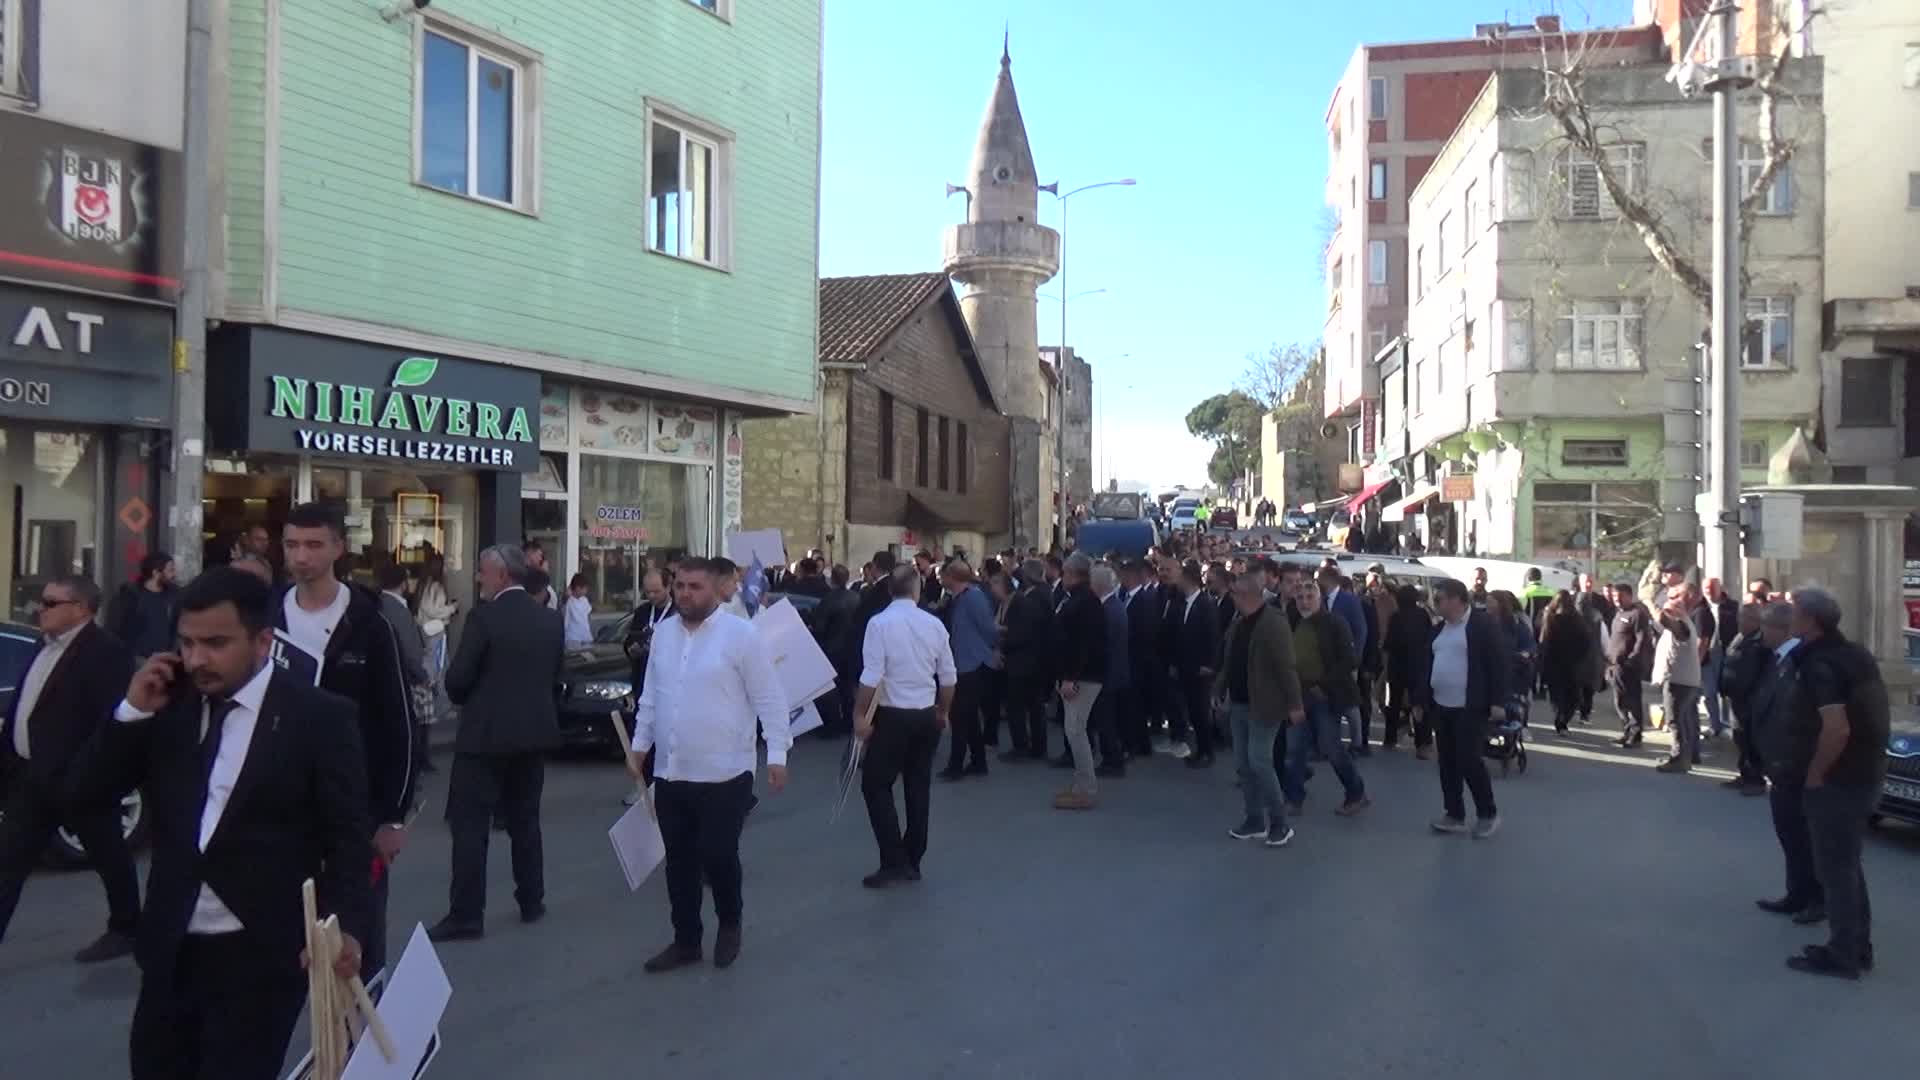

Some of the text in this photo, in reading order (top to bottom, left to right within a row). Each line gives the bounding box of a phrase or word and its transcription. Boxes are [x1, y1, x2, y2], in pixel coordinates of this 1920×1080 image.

[63, 154, 120, 184] BJK
[271, 375, 533, 442] NIHAVERA
[405, 440, 514, 467] LEZZETLER
